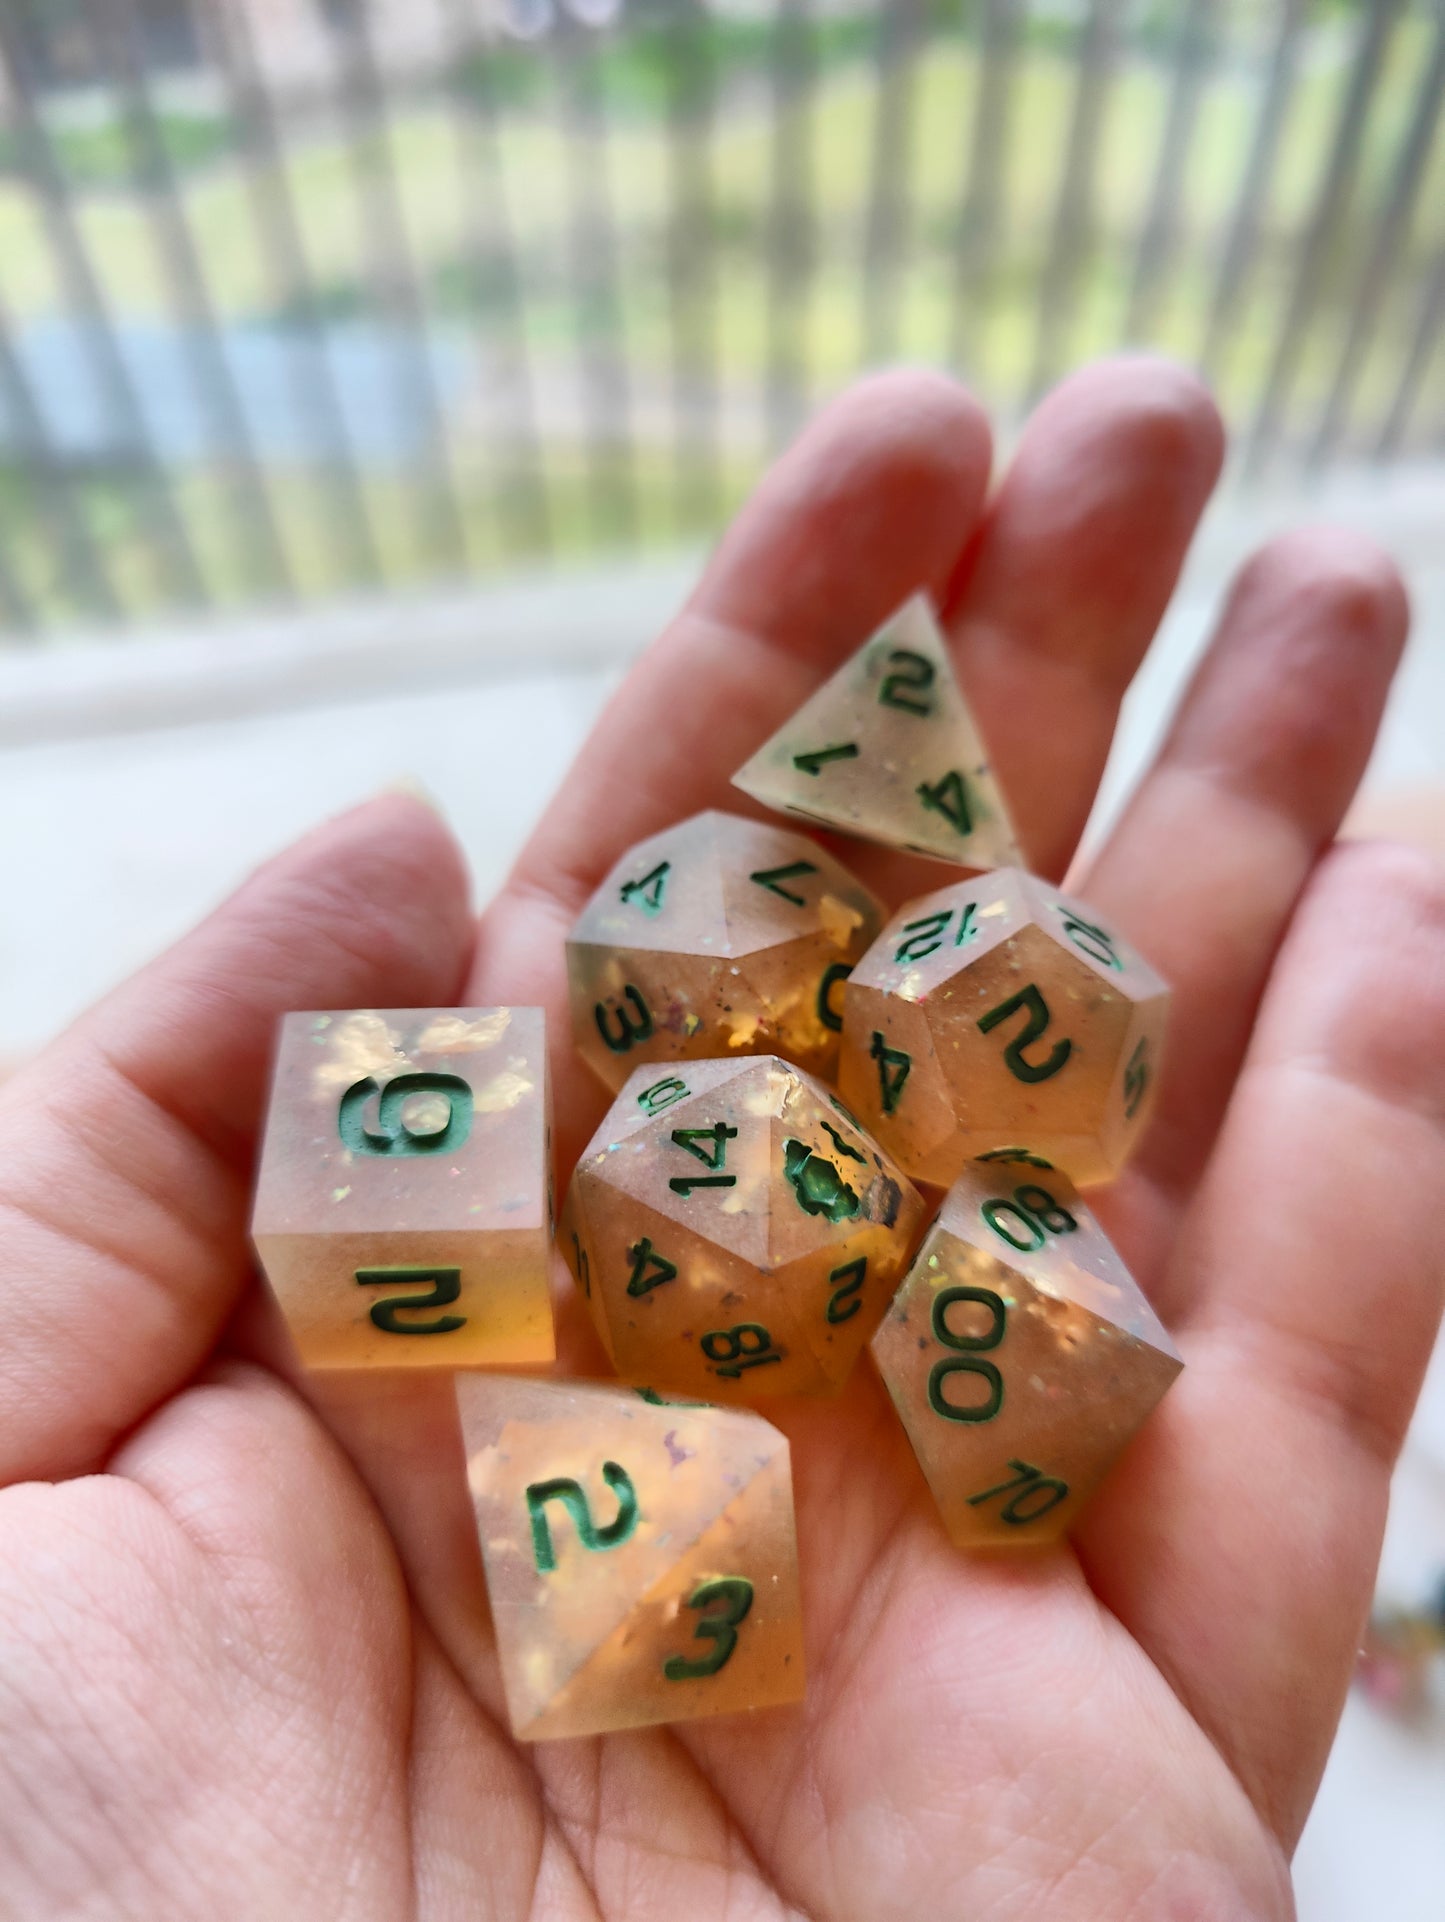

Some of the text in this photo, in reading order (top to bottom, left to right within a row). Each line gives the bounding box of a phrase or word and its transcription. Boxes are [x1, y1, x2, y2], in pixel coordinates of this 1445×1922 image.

[877, 650, 937, 718] 2
[792, 743, 860, 776] 1
[915, 770, 973, 837] 4
[620, 861, 671, 918] 4
[750, 860, 817, 906] 7
[594, 984, 654, 1054] 3
[976, 982, 1073, 1084] 2
[869, 1030, 913, 1115] 4
[668, 1121, 739, 1200] 14
[980, 1184, 1078, 1253] 80
[354, 1264, 468, 1335] 2
[625, 1236, 678, 1298] 4
[826, 1256, 868, 1324] 2
[927, 1285, 1008, 1424] 00
[526, 1460, 641, 1575] 2
[664, 1576, 755, 1681] 3
